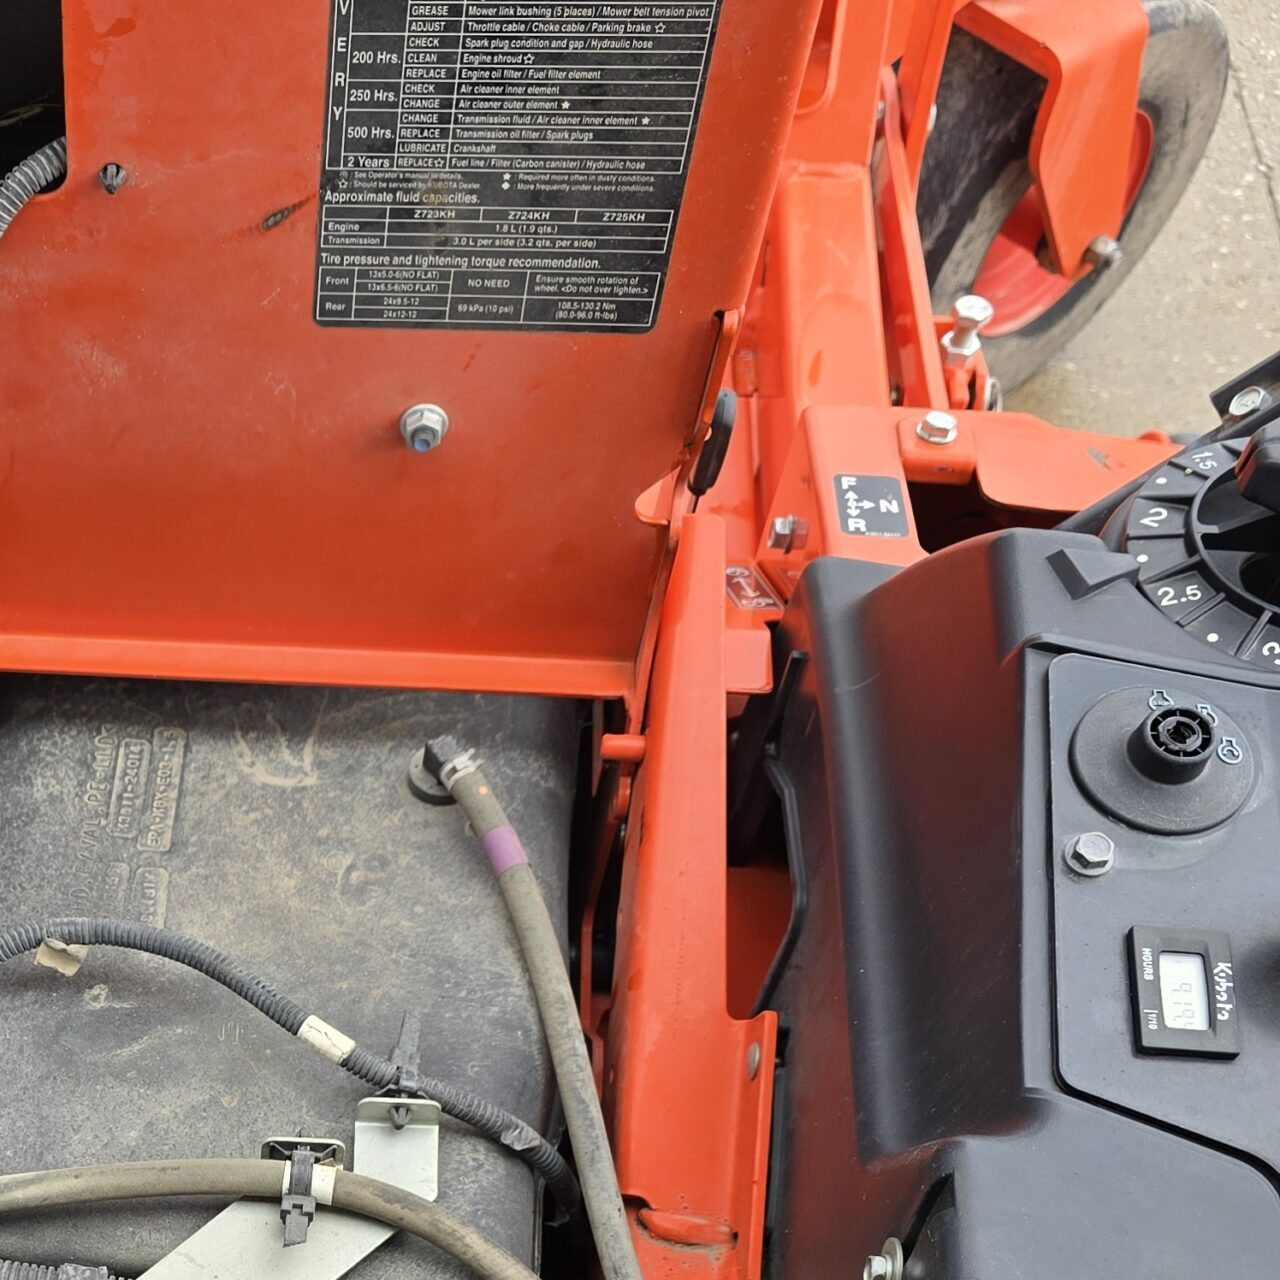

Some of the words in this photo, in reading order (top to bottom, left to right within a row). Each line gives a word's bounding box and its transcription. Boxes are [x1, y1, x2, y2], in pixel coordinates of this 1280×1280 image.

[411, 5, 448, 15] GREASE
[468, 5, 497, 15] Mower
[498, 6, 514, 15] link
[516, 5, 551, 17] bushing
[553, 6, 562, 17] (5
[563, 6, 595, 17] places)
[602, 6, 632, 16] Mower
[633, 6, 650, 16] belt
[651, 6, 684, 16] tension
[685, 6, 709, 18] pivot
[410, 21, 445, 31] ADJUST
[467, 21, 500, 31] Throttle
[502, 22, 525, 31] cable
[531, 22, 559, 32] Choke
[560, 22, 584, 32] cable
[591, 22, 624, 33] Parking
[626, 22, 651, 32] brake
[408, 37, 439, 46] CHECK
[465, 37, 489, 48] Spark
[490, 38, 509, 49] plug
[510, 38, 549, 47] condition
[550, 38, 567, 47] and
[568, 40, 584, 49] gap
[590, 38, 630, 49] Hydraulic
[631, 38, 653, 48] hose
[352, 50, 373, 63] 200
[376, 50, 400, 63] Hrs.
[407, 52, 437, 62] CLEAN
[462, 53, 491, 64] Engine
[493, 53, 522, 63] shroud
[405, 68, 446, 78] REPLACE
[404, 83, 434, 93] CHECK
[459, 84, 472, 93] Air
[473, 84, 503, 94] cleaner
[504, 84, 526, 94] inner
[526, 84, 559, 94] element
[349, 88, 370, 101] 250
[373, 88, 397, 101] Hrs.
[347, 126, 368, 138] 500
[370, 126, 394, 138] Hrs.
[399, 142, 446, 152] LUBRICATE
[453, 143, 496, 153] Crankshaft
[347, 156, 354, 167] 2
[357, 156, 389, 168] Years
[324, 189, 393, 204] Approximate
[395, 190, 420, 202] fluid
[422, 191, 480, 205] capacities.
[413, 209, 455, 218] Z723KH
[507, 210, 549, 219] Z724KH
[602, 212, 645, 221] Z725KH
[328, 221, 359, 231] Engine
[328, 235, 380, 244] Transmission
[320, 252, 341, 264] Tire
[343, 255, 390, 266] pressure
[392, 254, 412, 265] and
[414, 254, 468, 268] tightening
[471, 255, 505, 268] torque
[508, 256, 600, 268] recommendation.
[325, 276, 349, 284] Front
[467, 278, 482, 287] NO
[483, 279, 510, 287] NEED
[325, 302, 345, 310] Rear
[1192, 451, 1217, 470] 1.5
[841, 477, 857, 489] F
[880, 499, 899, 513] N
[1140, 508, 1168, 528] 2
[848, 518, 866, 532] R
[1157, 585, 1202, 606] 2.5
[1142, 948, 1154, 980] HOURS
[1214, 962, 1233, 1020] Kubota
